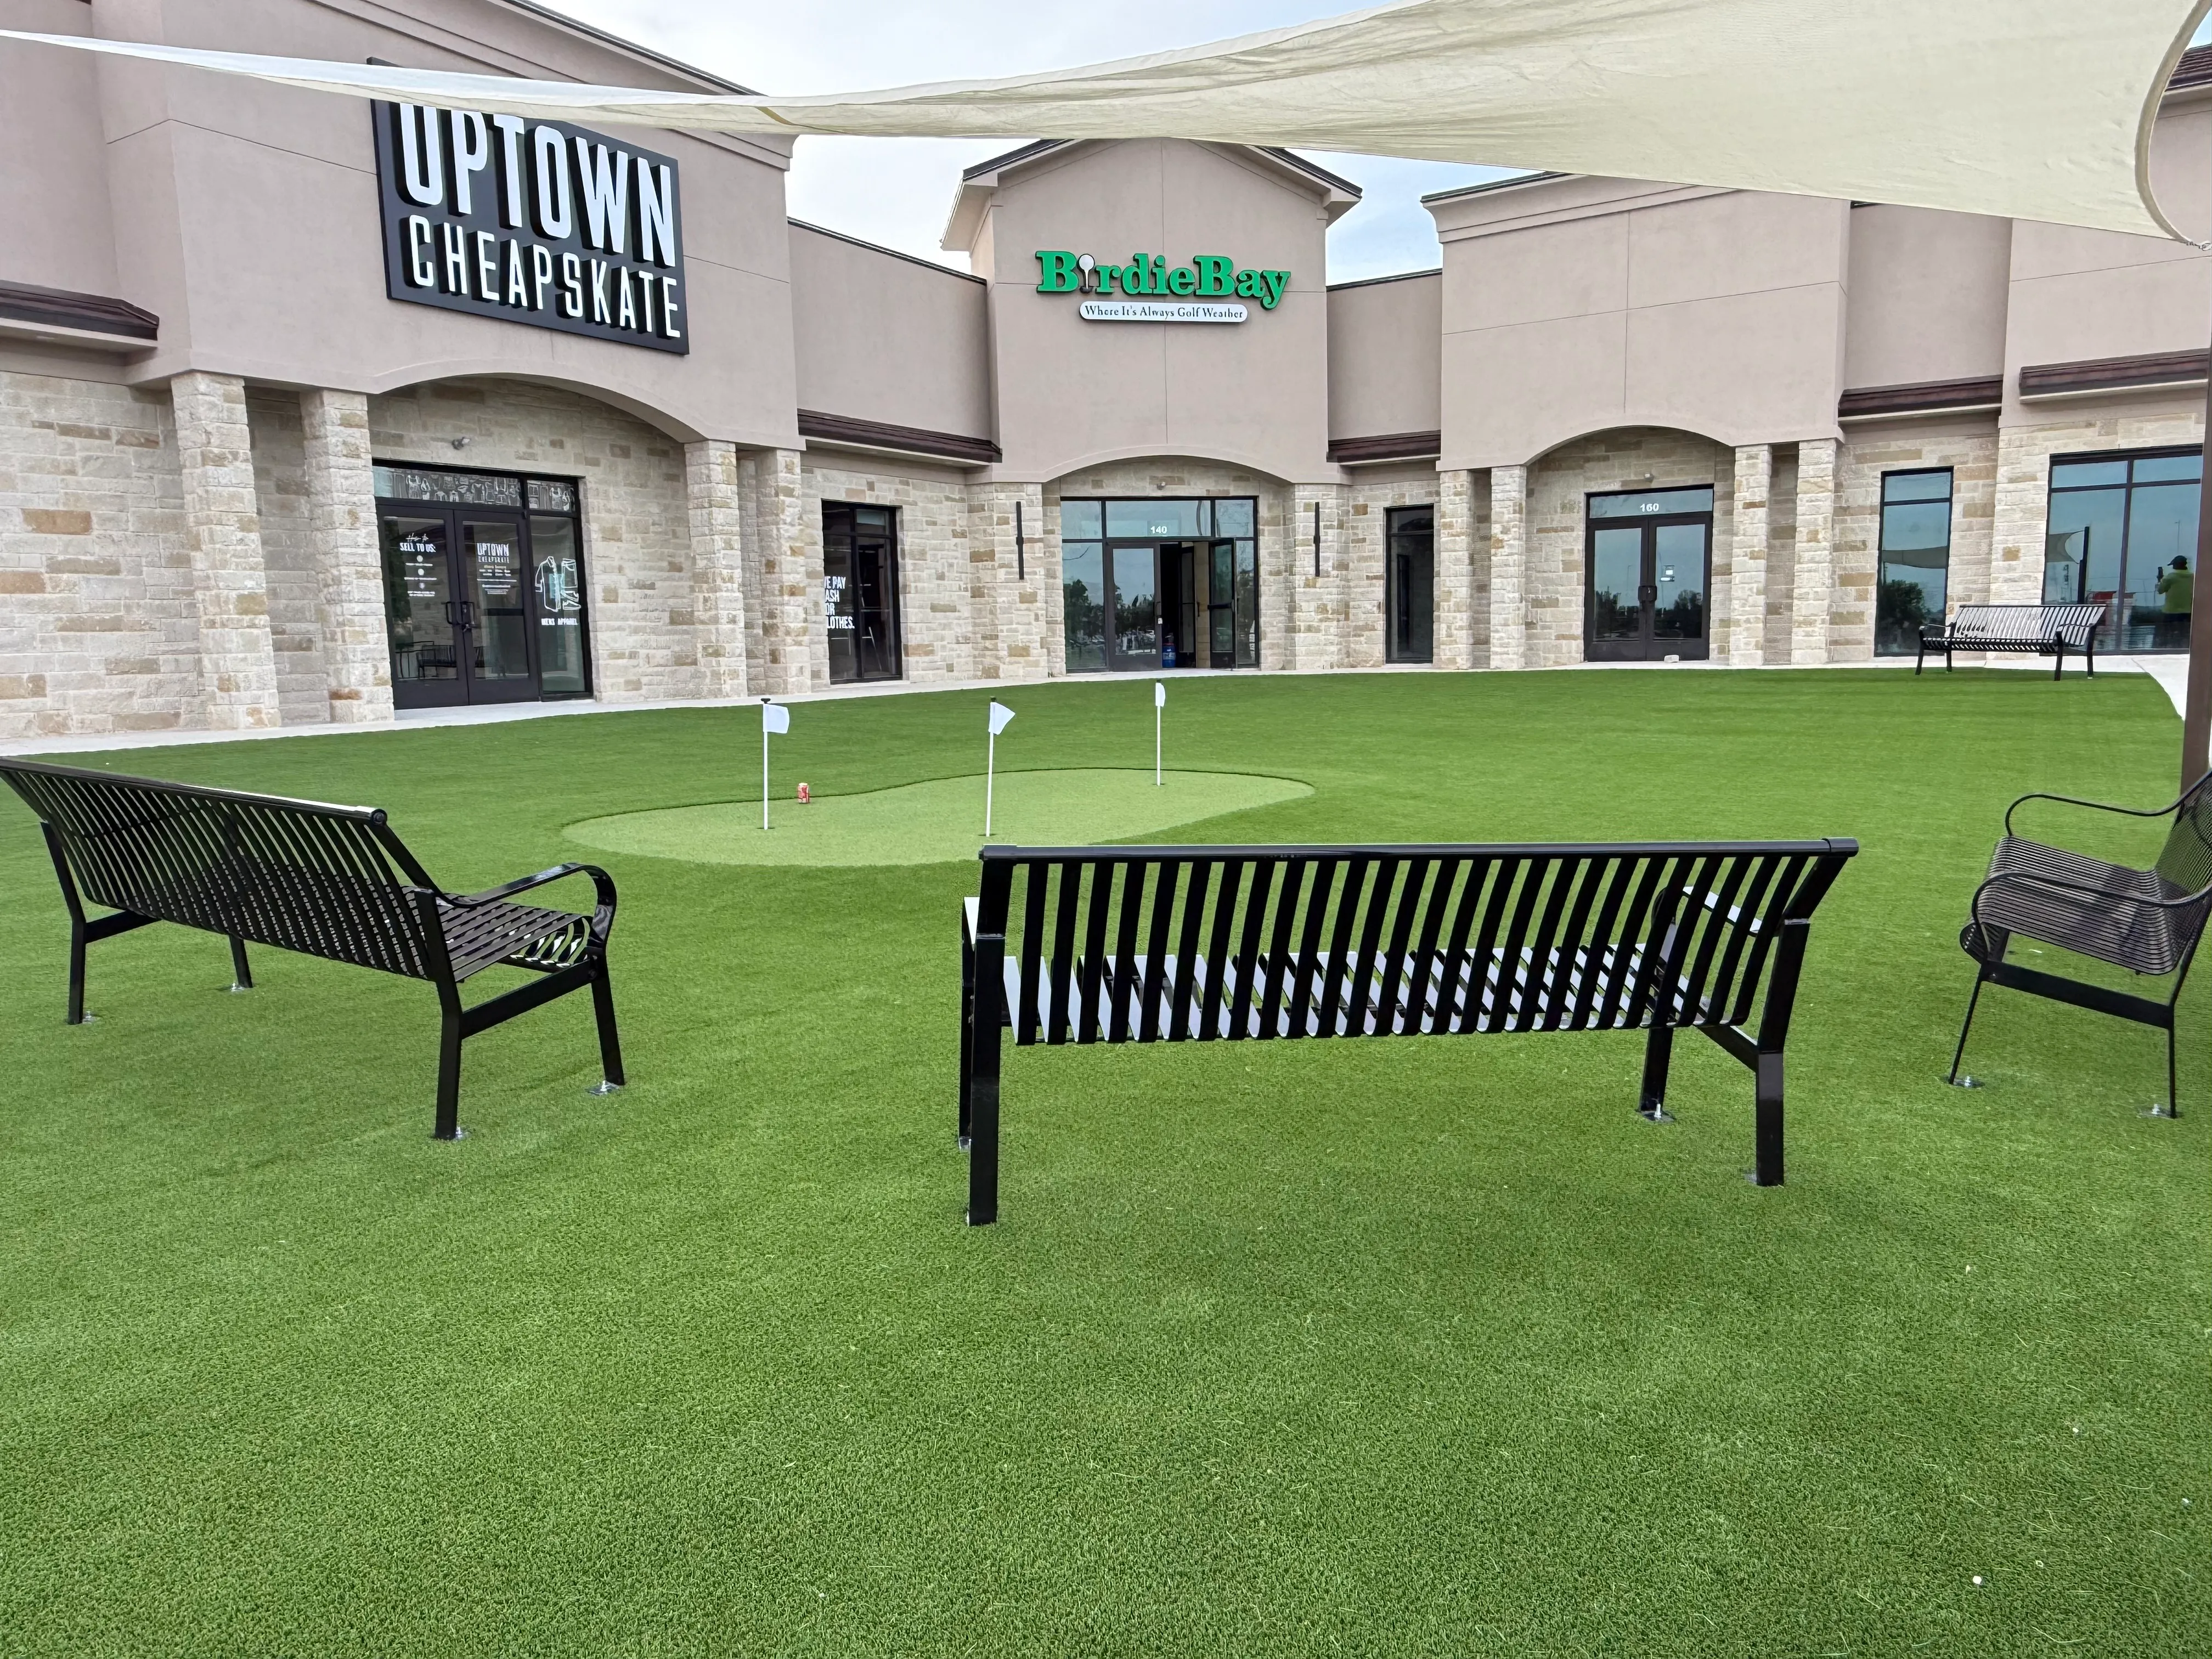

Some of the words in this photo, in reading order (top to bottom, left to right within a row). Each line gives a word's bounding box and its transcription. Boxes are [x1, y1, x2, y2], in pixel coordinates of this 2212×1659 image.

[399, 102, 676, 267] UPTOWN
[408, 214, 681, 338] CHEAPSKATE
[1036, 251, 1291, 311] BirdieBay
[1085, 305, 1119, 316] Where
[1122, 305, 1137, 316] It's
[1139, 306, 1175, 320] Always
[1177, 307, 1200, 317] Golf
[1203, 307, 1243, 318] Weather
[1640, 503, 1660, 512] 160
[1150, 525, 1168, 534] 140
[399, 542, 415, 552] SELL
[416, 543, 425, 552] TO
[477, 543, 510, 556] UPTOWN
[832, 576, 846, 589] PAY
[825, 589, 840, 602] ASH
[825, 602, 835, 616] OR
[826, 616, 855, 629] LOTHES.
